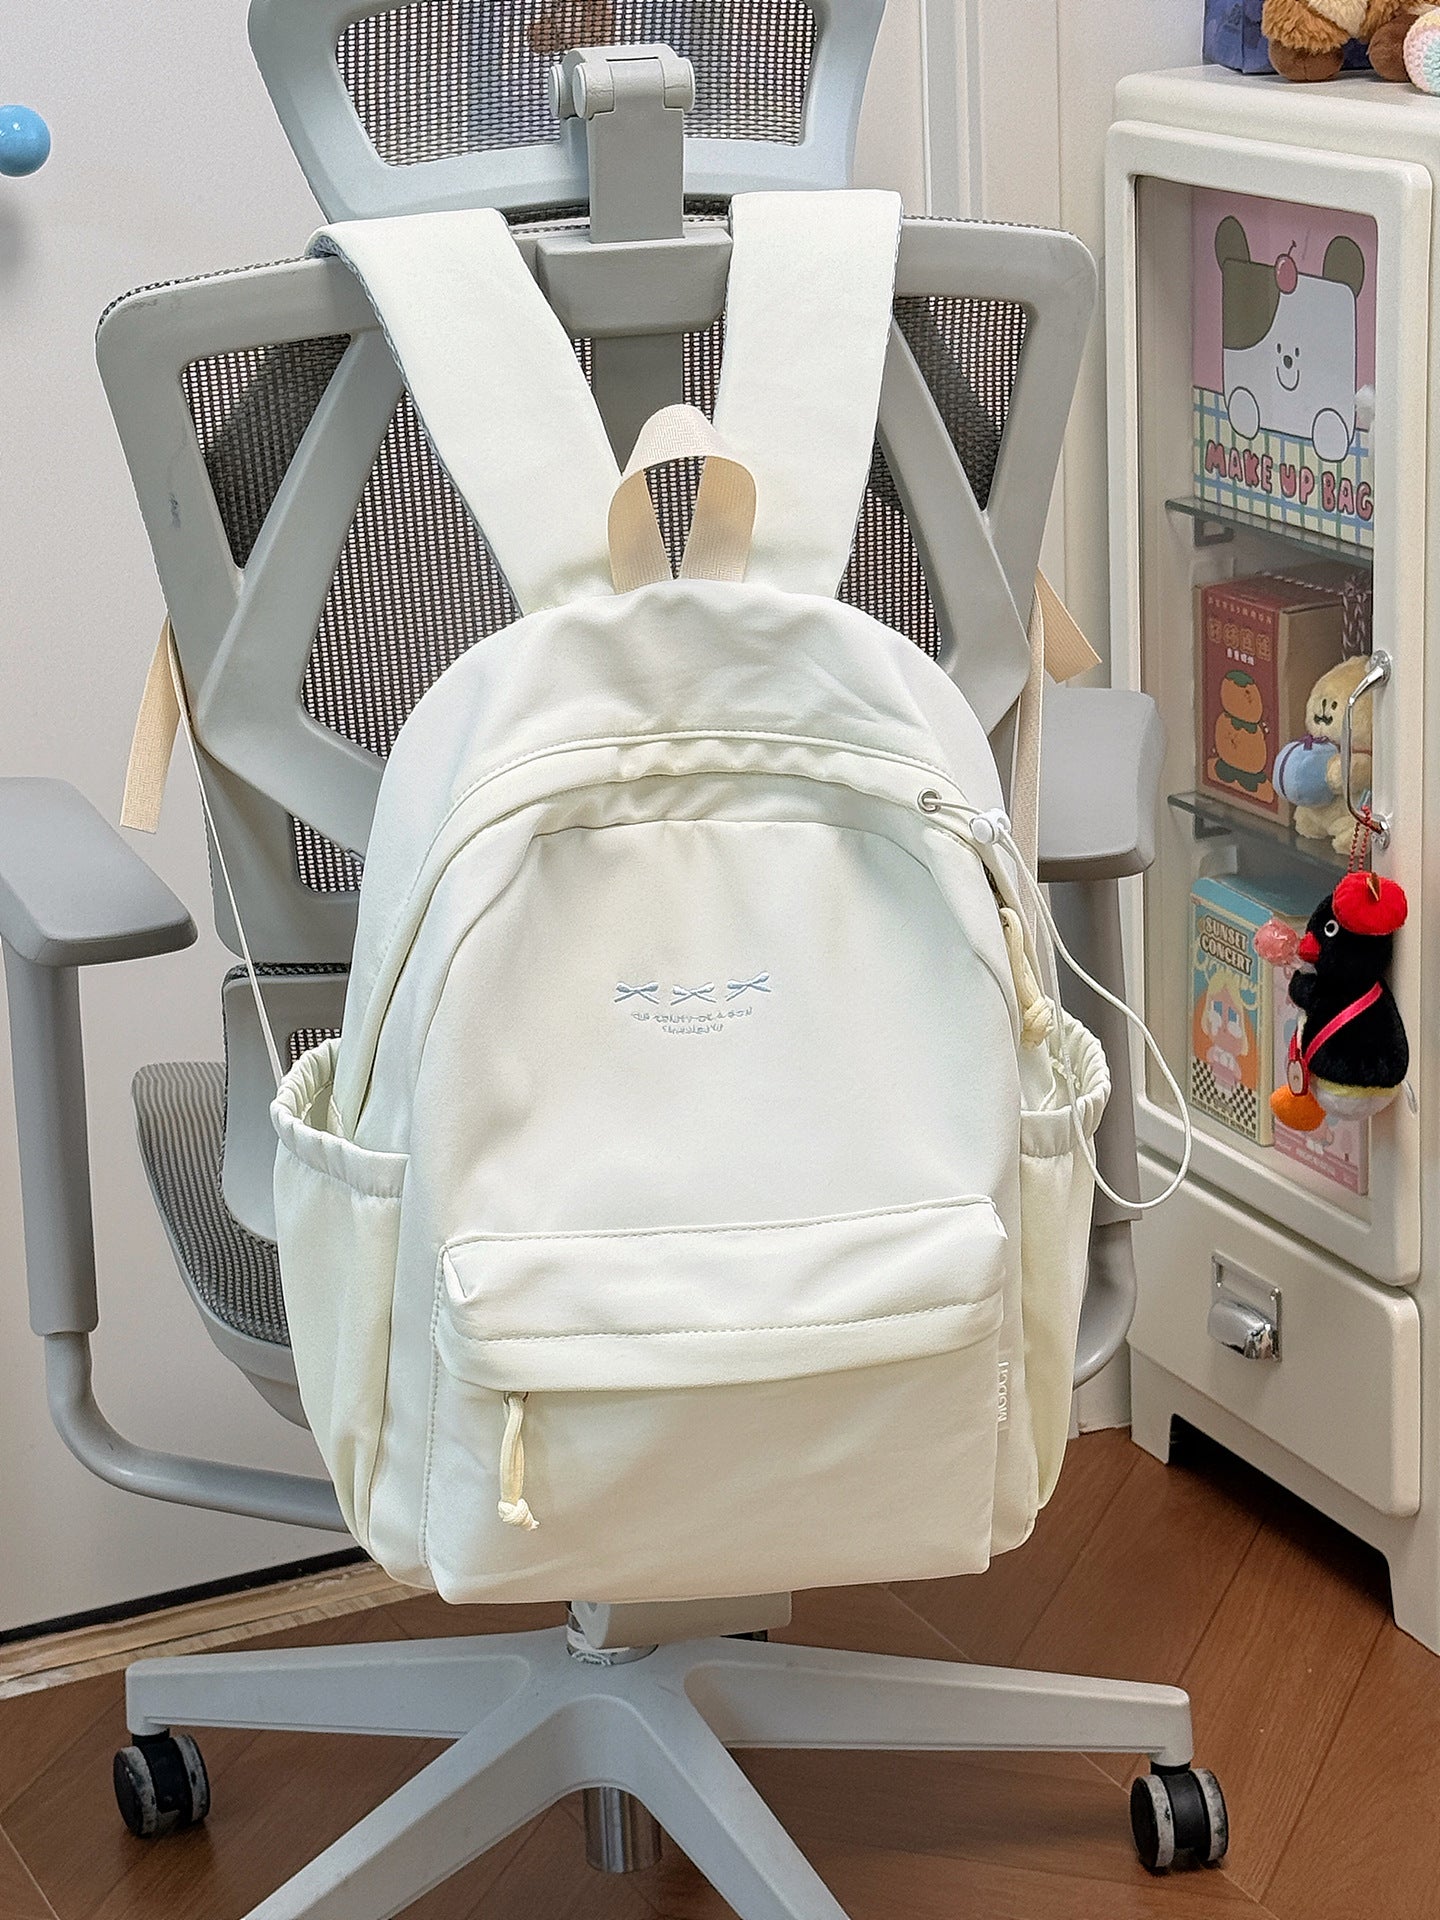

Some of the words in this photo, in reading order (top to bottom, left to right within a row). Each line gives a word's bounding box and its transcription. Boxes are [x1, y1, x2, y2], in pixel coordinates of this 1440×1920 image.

[1205, 439, 1273, 493] MAKE
[1279, 463, 1315, 505] UP
[1321, 471, 1374, 521] BAG
[1200, 933, 1252, 976] CONCERT
[1205, 915, 1248, 952] SUNSET
